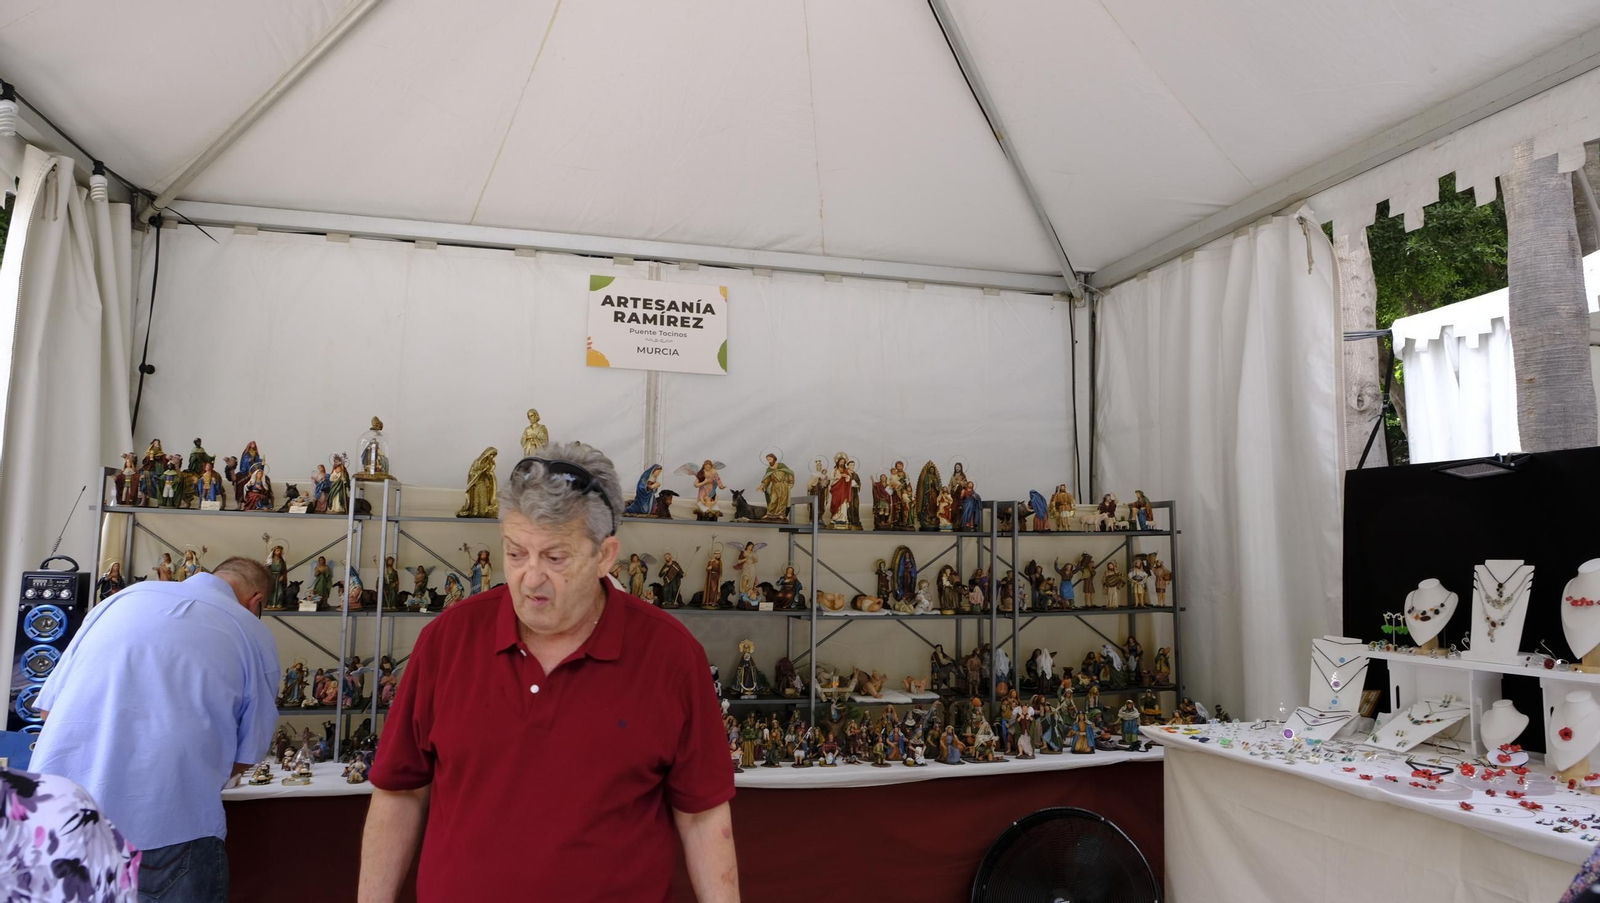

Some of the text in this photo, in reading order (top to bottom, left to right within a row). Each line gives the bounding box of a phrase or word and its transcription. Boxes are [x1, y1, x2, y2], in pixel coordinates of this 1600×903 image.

[601, 295, 716, 315] ARTESANÍA
[614, 310, 704, 329] RAMÍREZ
[629, 328, 687, 338] Puente Tocinos
[637, 346, 680, 356] MURCIA
